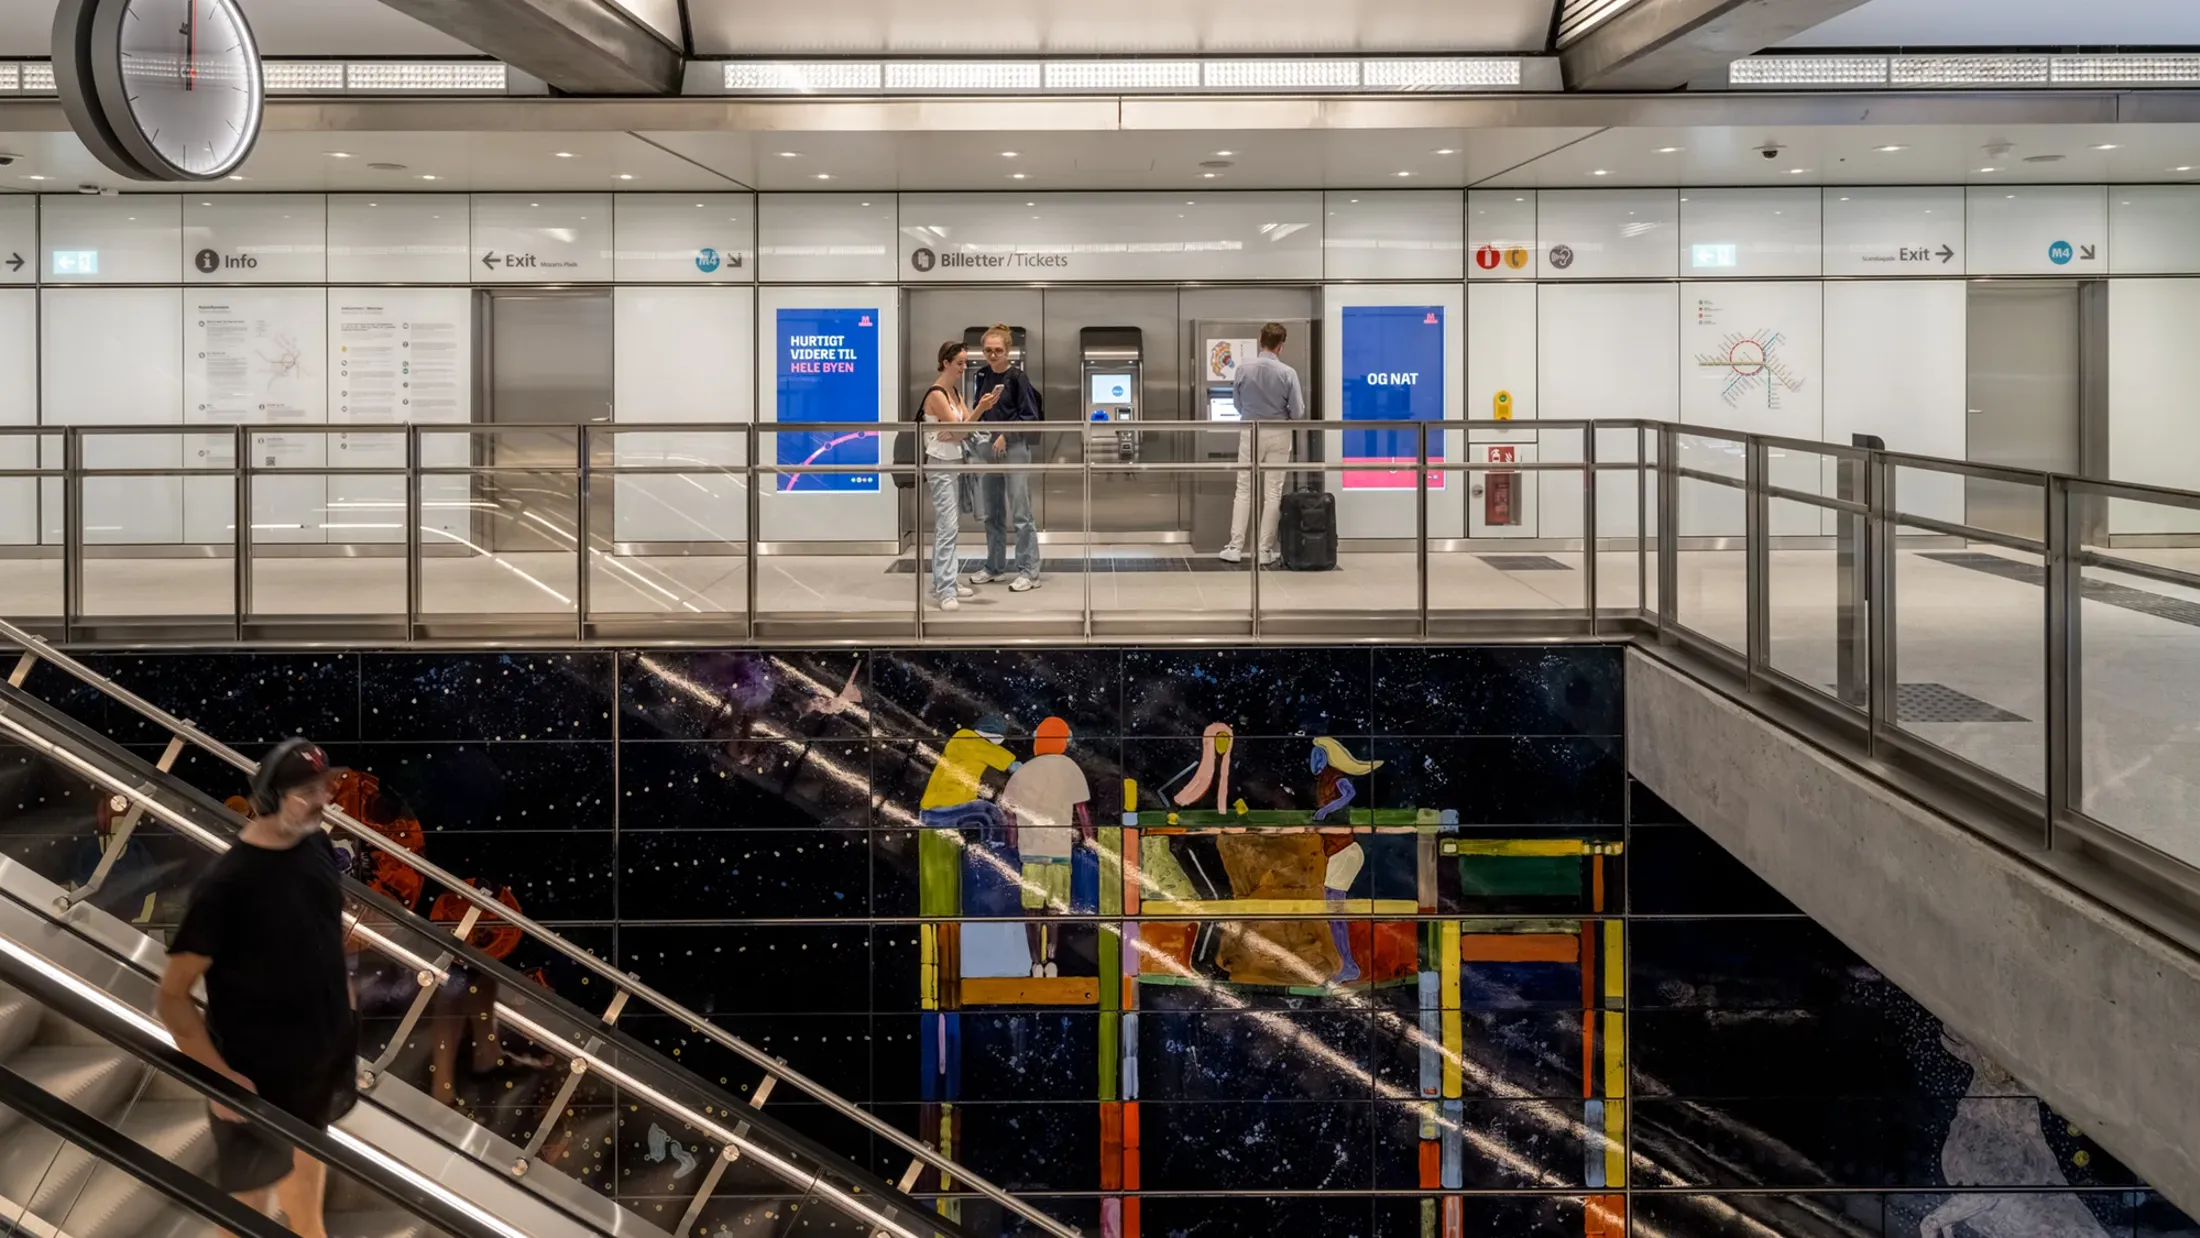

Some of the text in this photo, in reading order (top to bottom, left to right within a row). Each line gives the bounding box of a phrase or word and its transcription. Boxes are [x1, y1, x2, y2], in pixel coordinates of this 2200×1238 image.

[1899, 247, 1930, 261] Exit
[2051, 247, 2070, 258] M4
[225, 253, 257, 268] Info
[505, 253, 536, 267] Exit
[941, 253, 1004, 267] Billetter
[1015, 253, 1068, 267] Tickets
[790, 335, 845, 347] HURTIGT
[790, 349, 857, 360] VIDERE TIL
[790, 362, 854, 373] HELE BYEN
[1367, 372, 1419, 385] OG NAT
